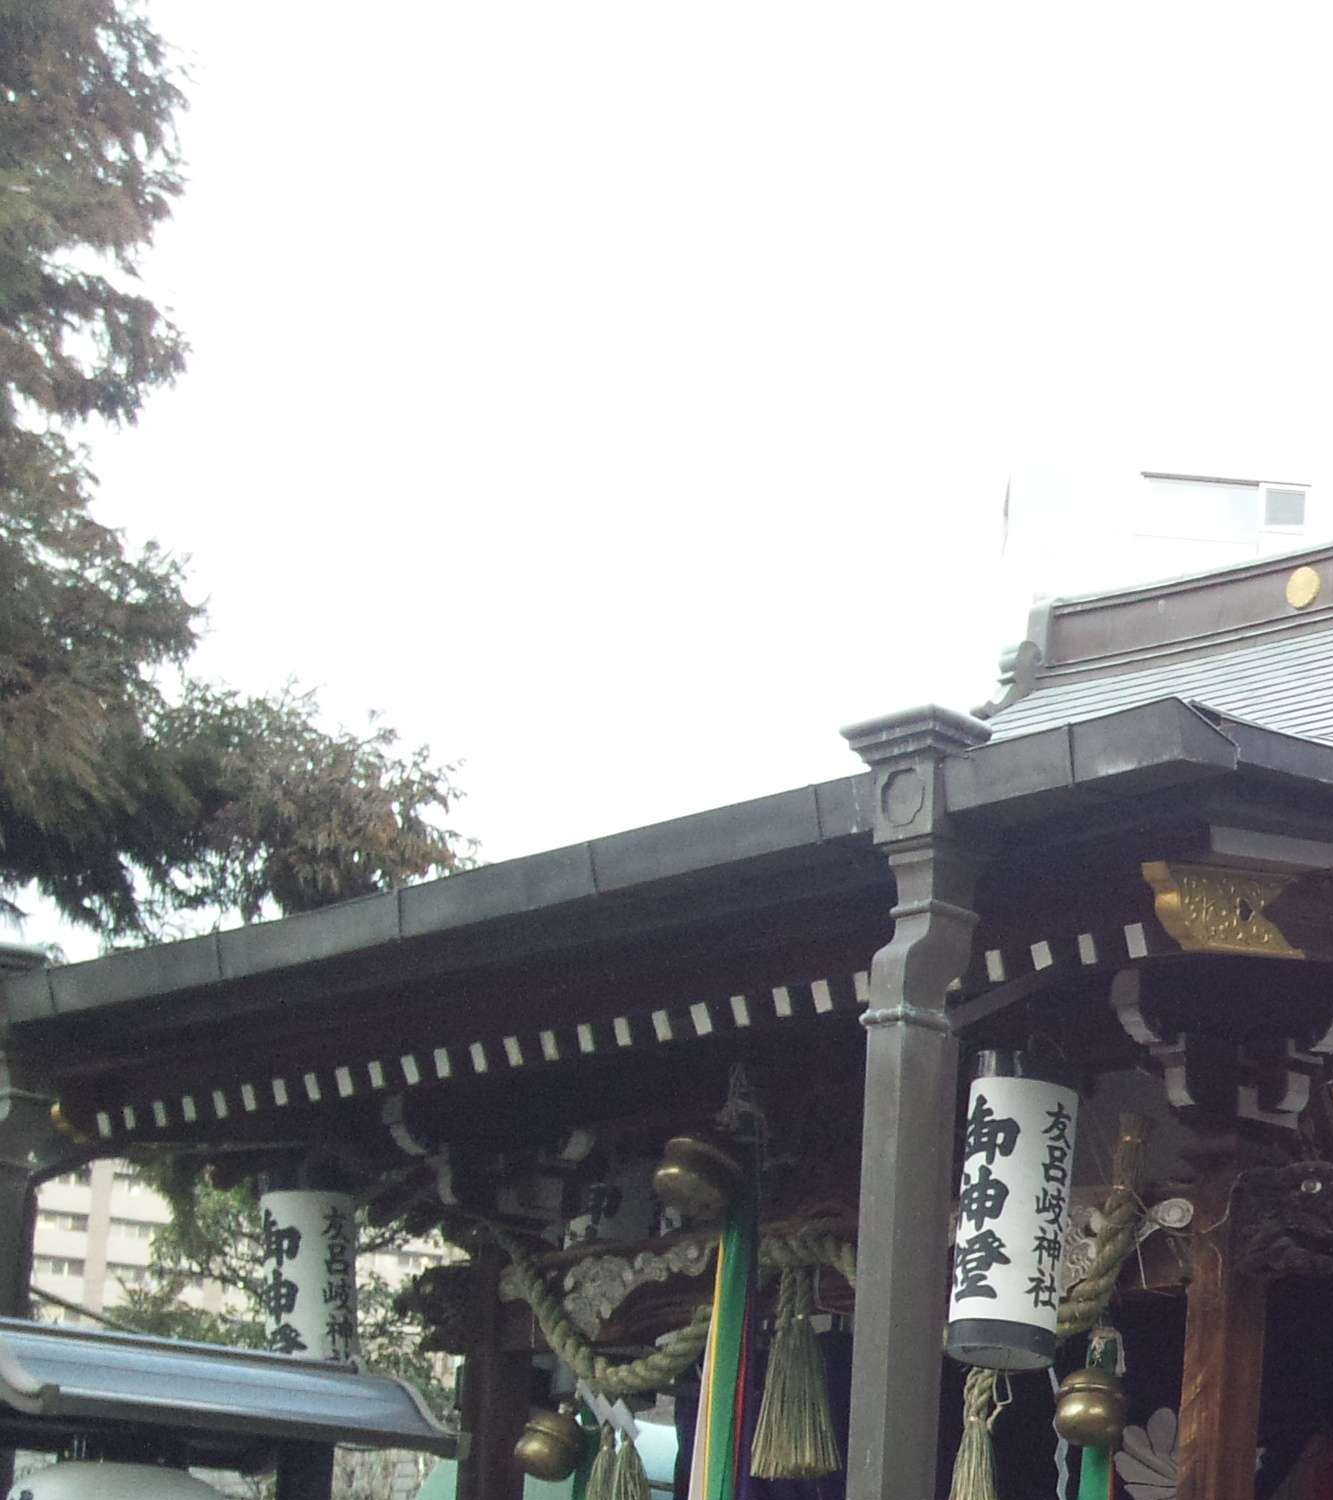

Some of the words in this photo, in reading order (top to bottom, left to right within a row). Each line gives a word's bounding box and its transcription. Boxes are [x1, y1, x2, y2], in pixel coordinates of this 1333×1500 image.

[1025, 1102, 1070, 1310] 友呂岐神社
